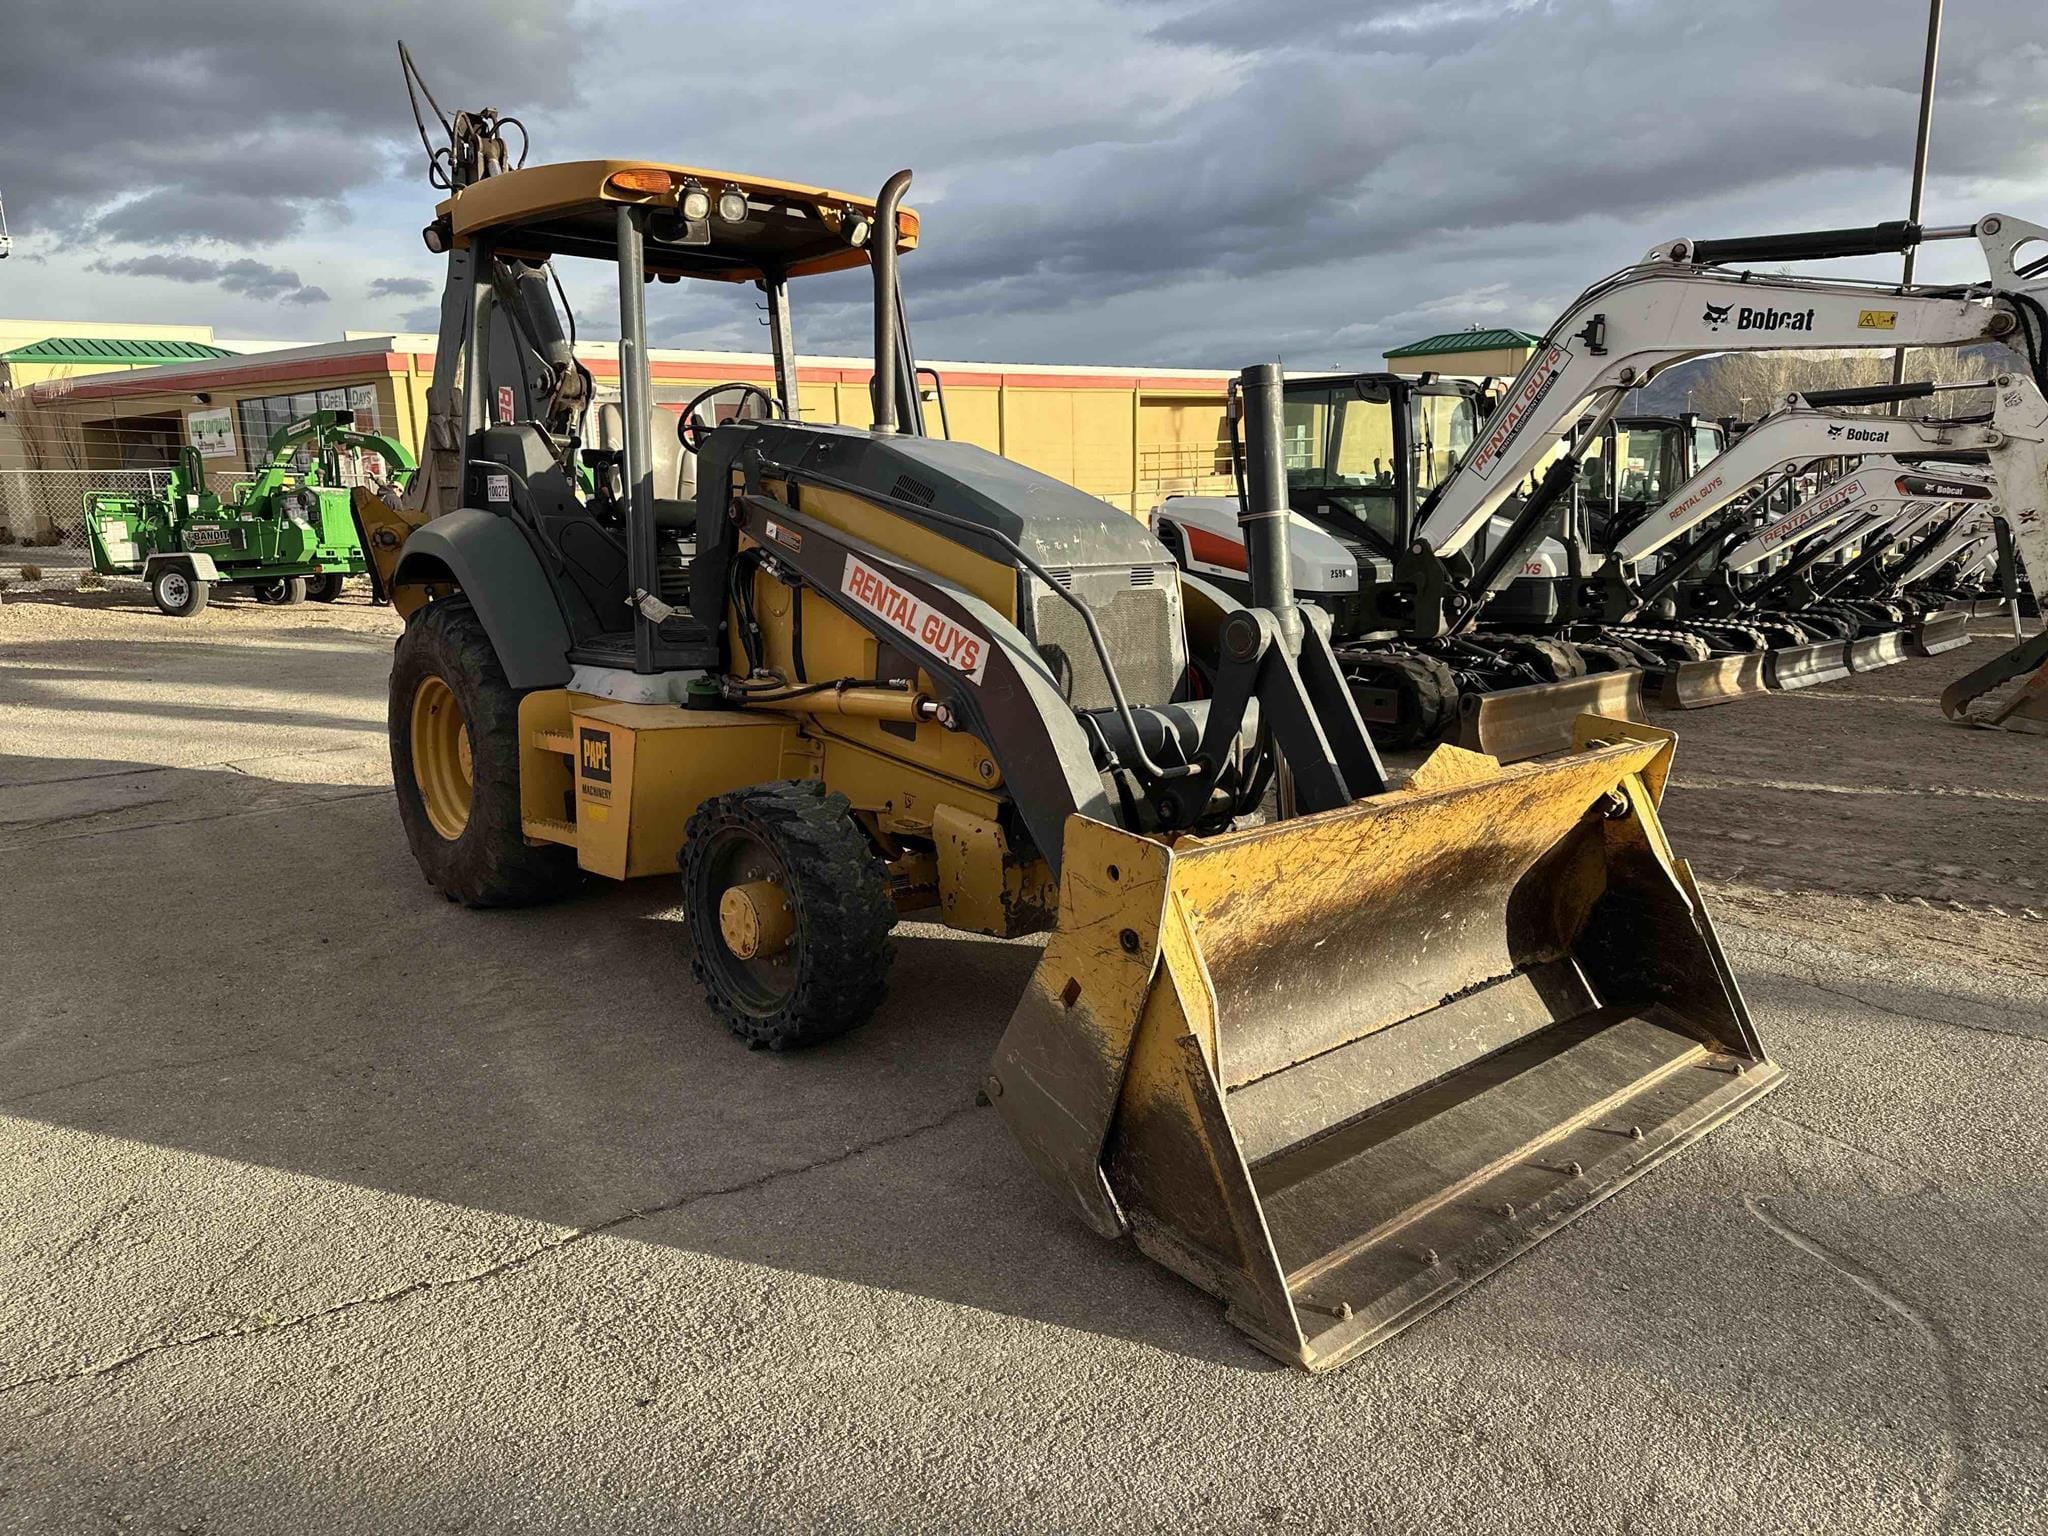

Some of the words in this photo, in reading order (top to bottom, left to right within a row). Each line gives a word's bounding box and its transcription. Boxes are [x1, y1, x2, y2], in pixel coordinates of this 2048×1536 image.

[1738, 307, 1815, 331] Bobcat
[323, 393, 343, 409] OPEN
[352, 390, 372, 406] DAYS
[1537, 375, 1556, 401] CENTER
[1474, 402, 1527, 471] RENTAL
[1524, 348, 1561, 402] GUYS
[1847, 428, 1889, 443] Bobcat
[1669, 496, 1701, 521] RENTAL
[1700, 476, 1723, 498] GUYS
[1936, 486, 1964, 496] Bobcat
[1764, 508, 1817, 544] RENTAL
[1819, 483, 1859, 511] GUYS
[194, 530, 228, 541] BANDIT
[848, 566, 918, 635] RENTAL
[921, 614, 980, 669] GUYS
[582, 784, 612, 800] MACHINERY
